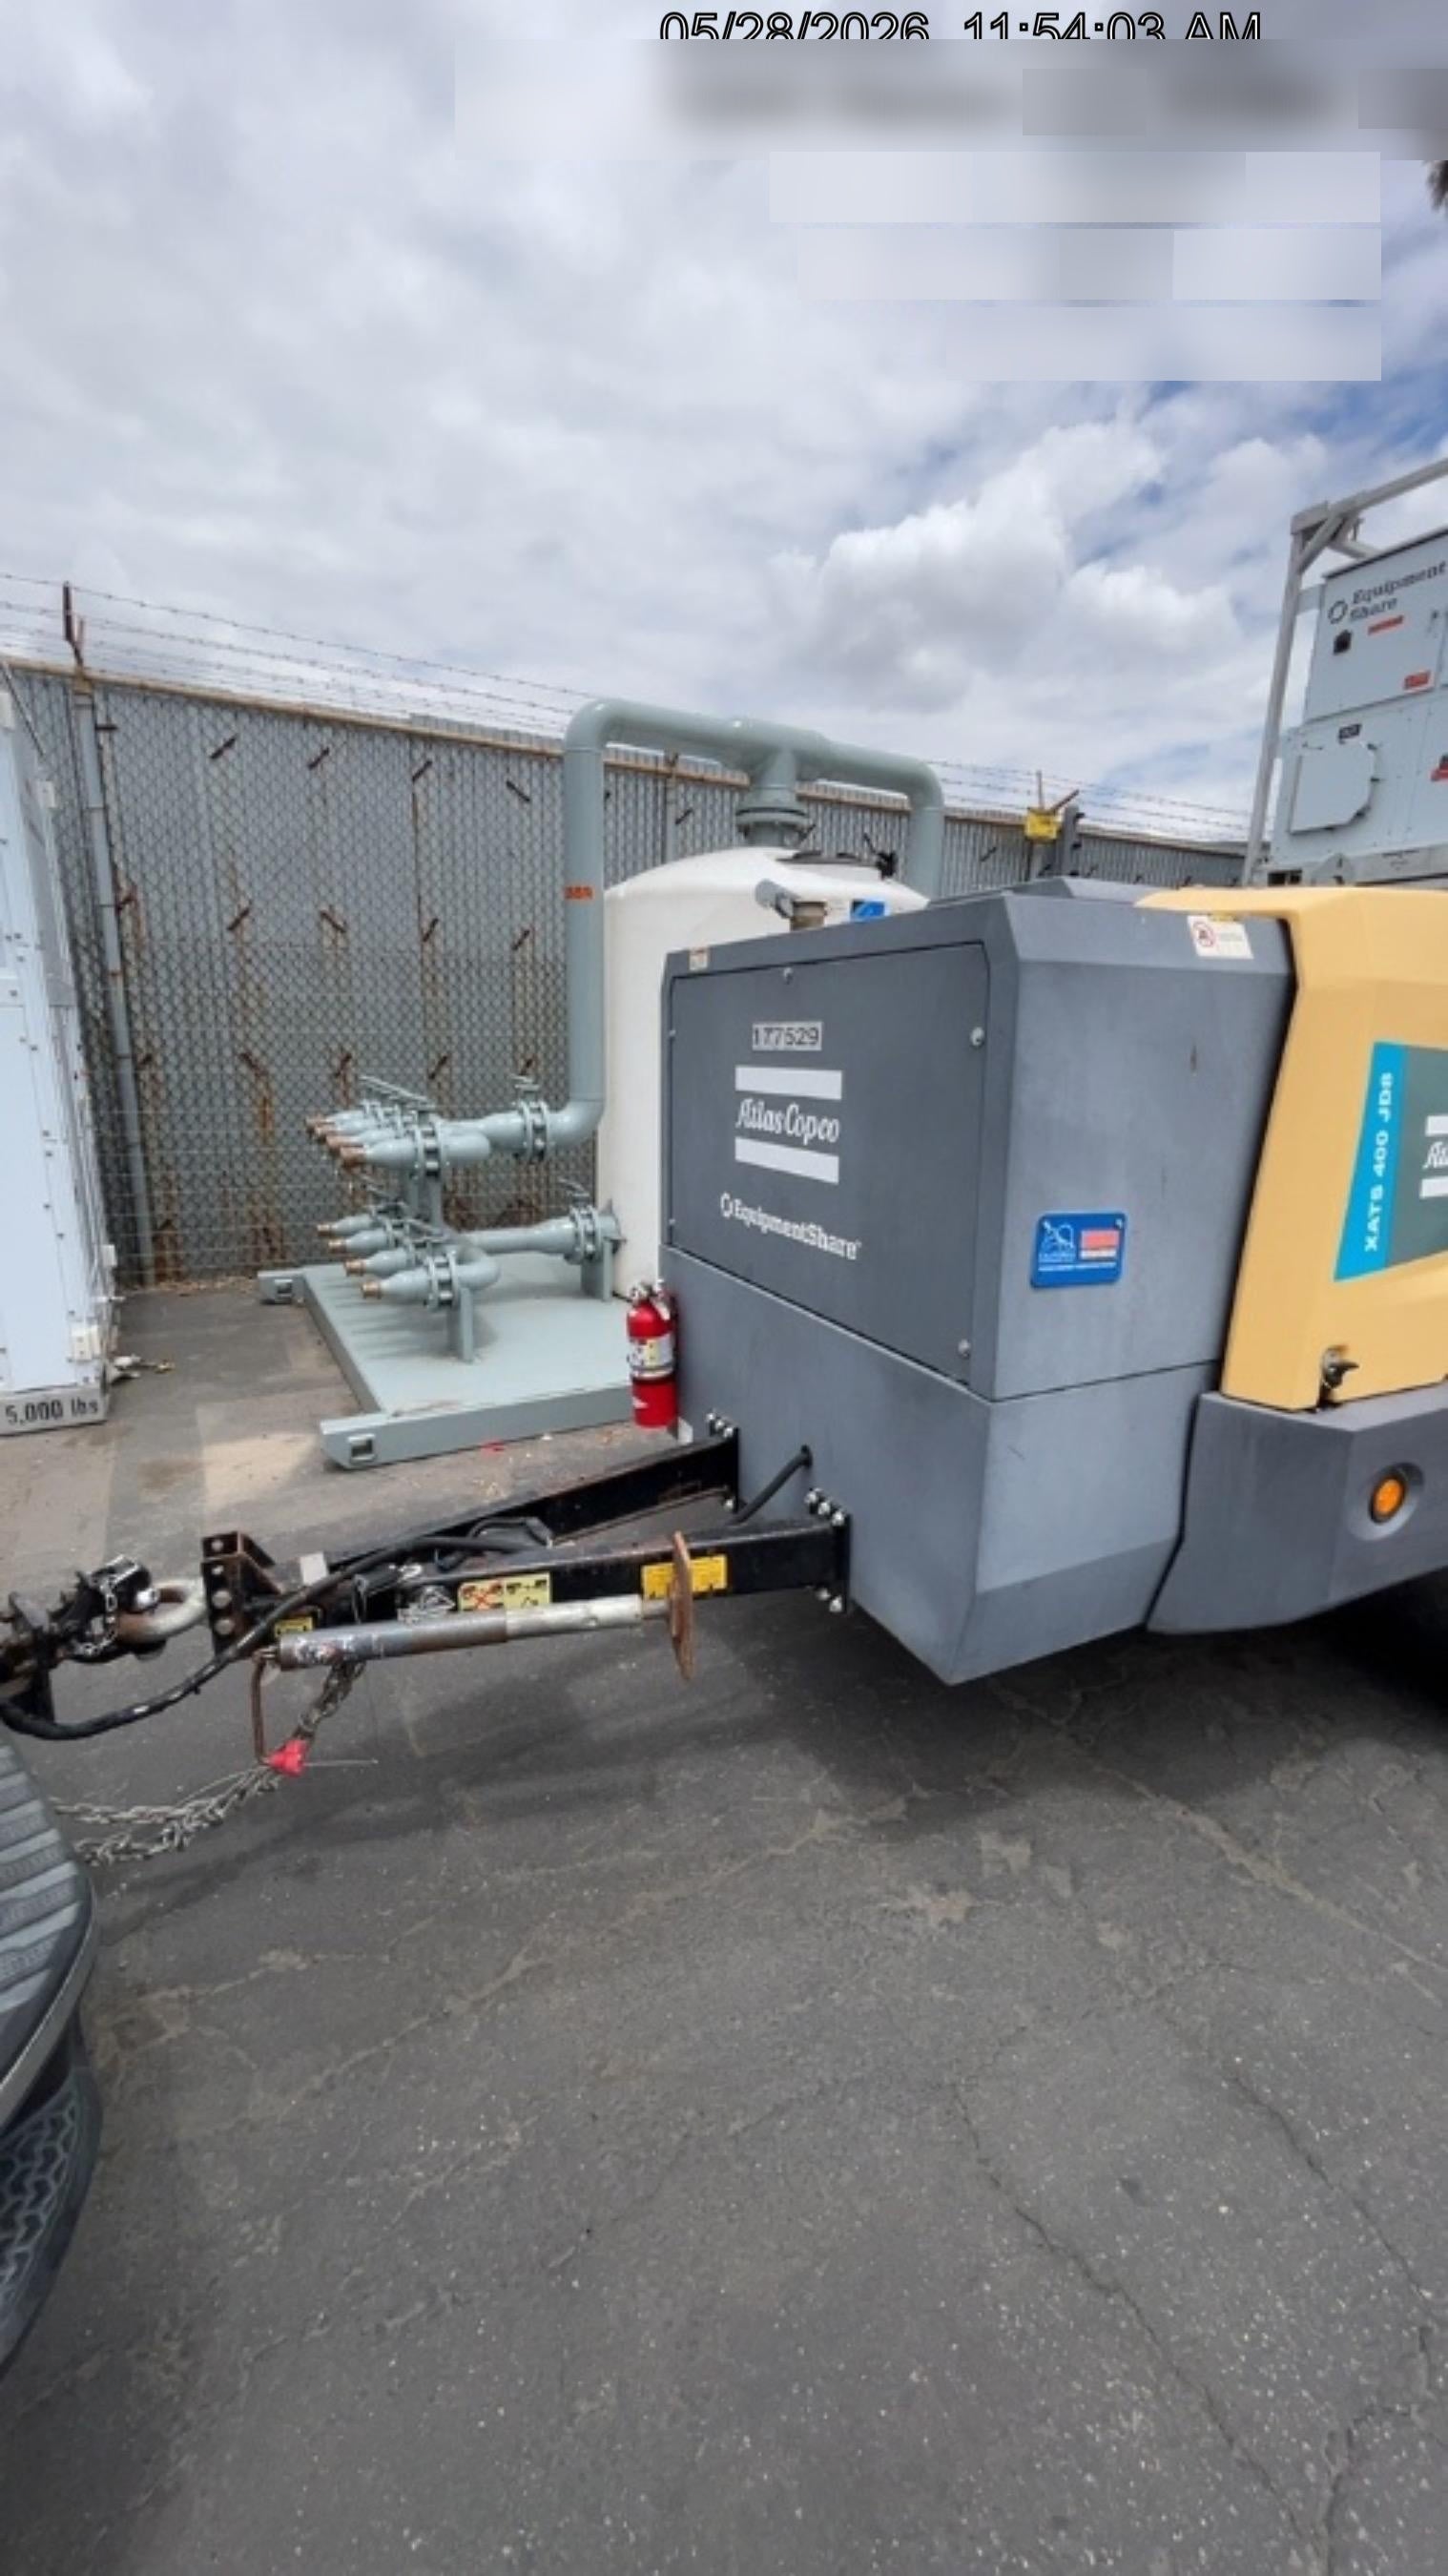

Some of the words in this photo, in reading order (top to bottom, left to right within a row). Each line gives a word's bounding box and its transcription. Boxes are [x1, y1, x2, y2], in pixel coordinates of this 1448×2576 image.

[1353, 560, 1446, 604] Equipment
[1350, 597, 1397, 622] Share
[754, 1027, 820, 1046] 177529
[735, 1098, 784, 1134] Atlas
[785, 1102, 840, 1145] Copco
[1364, 1184, 1383, 1252] XATS
[1374, 1130, 1389, 1177] 400
[6, 1399, 63, 1425] 5,000
